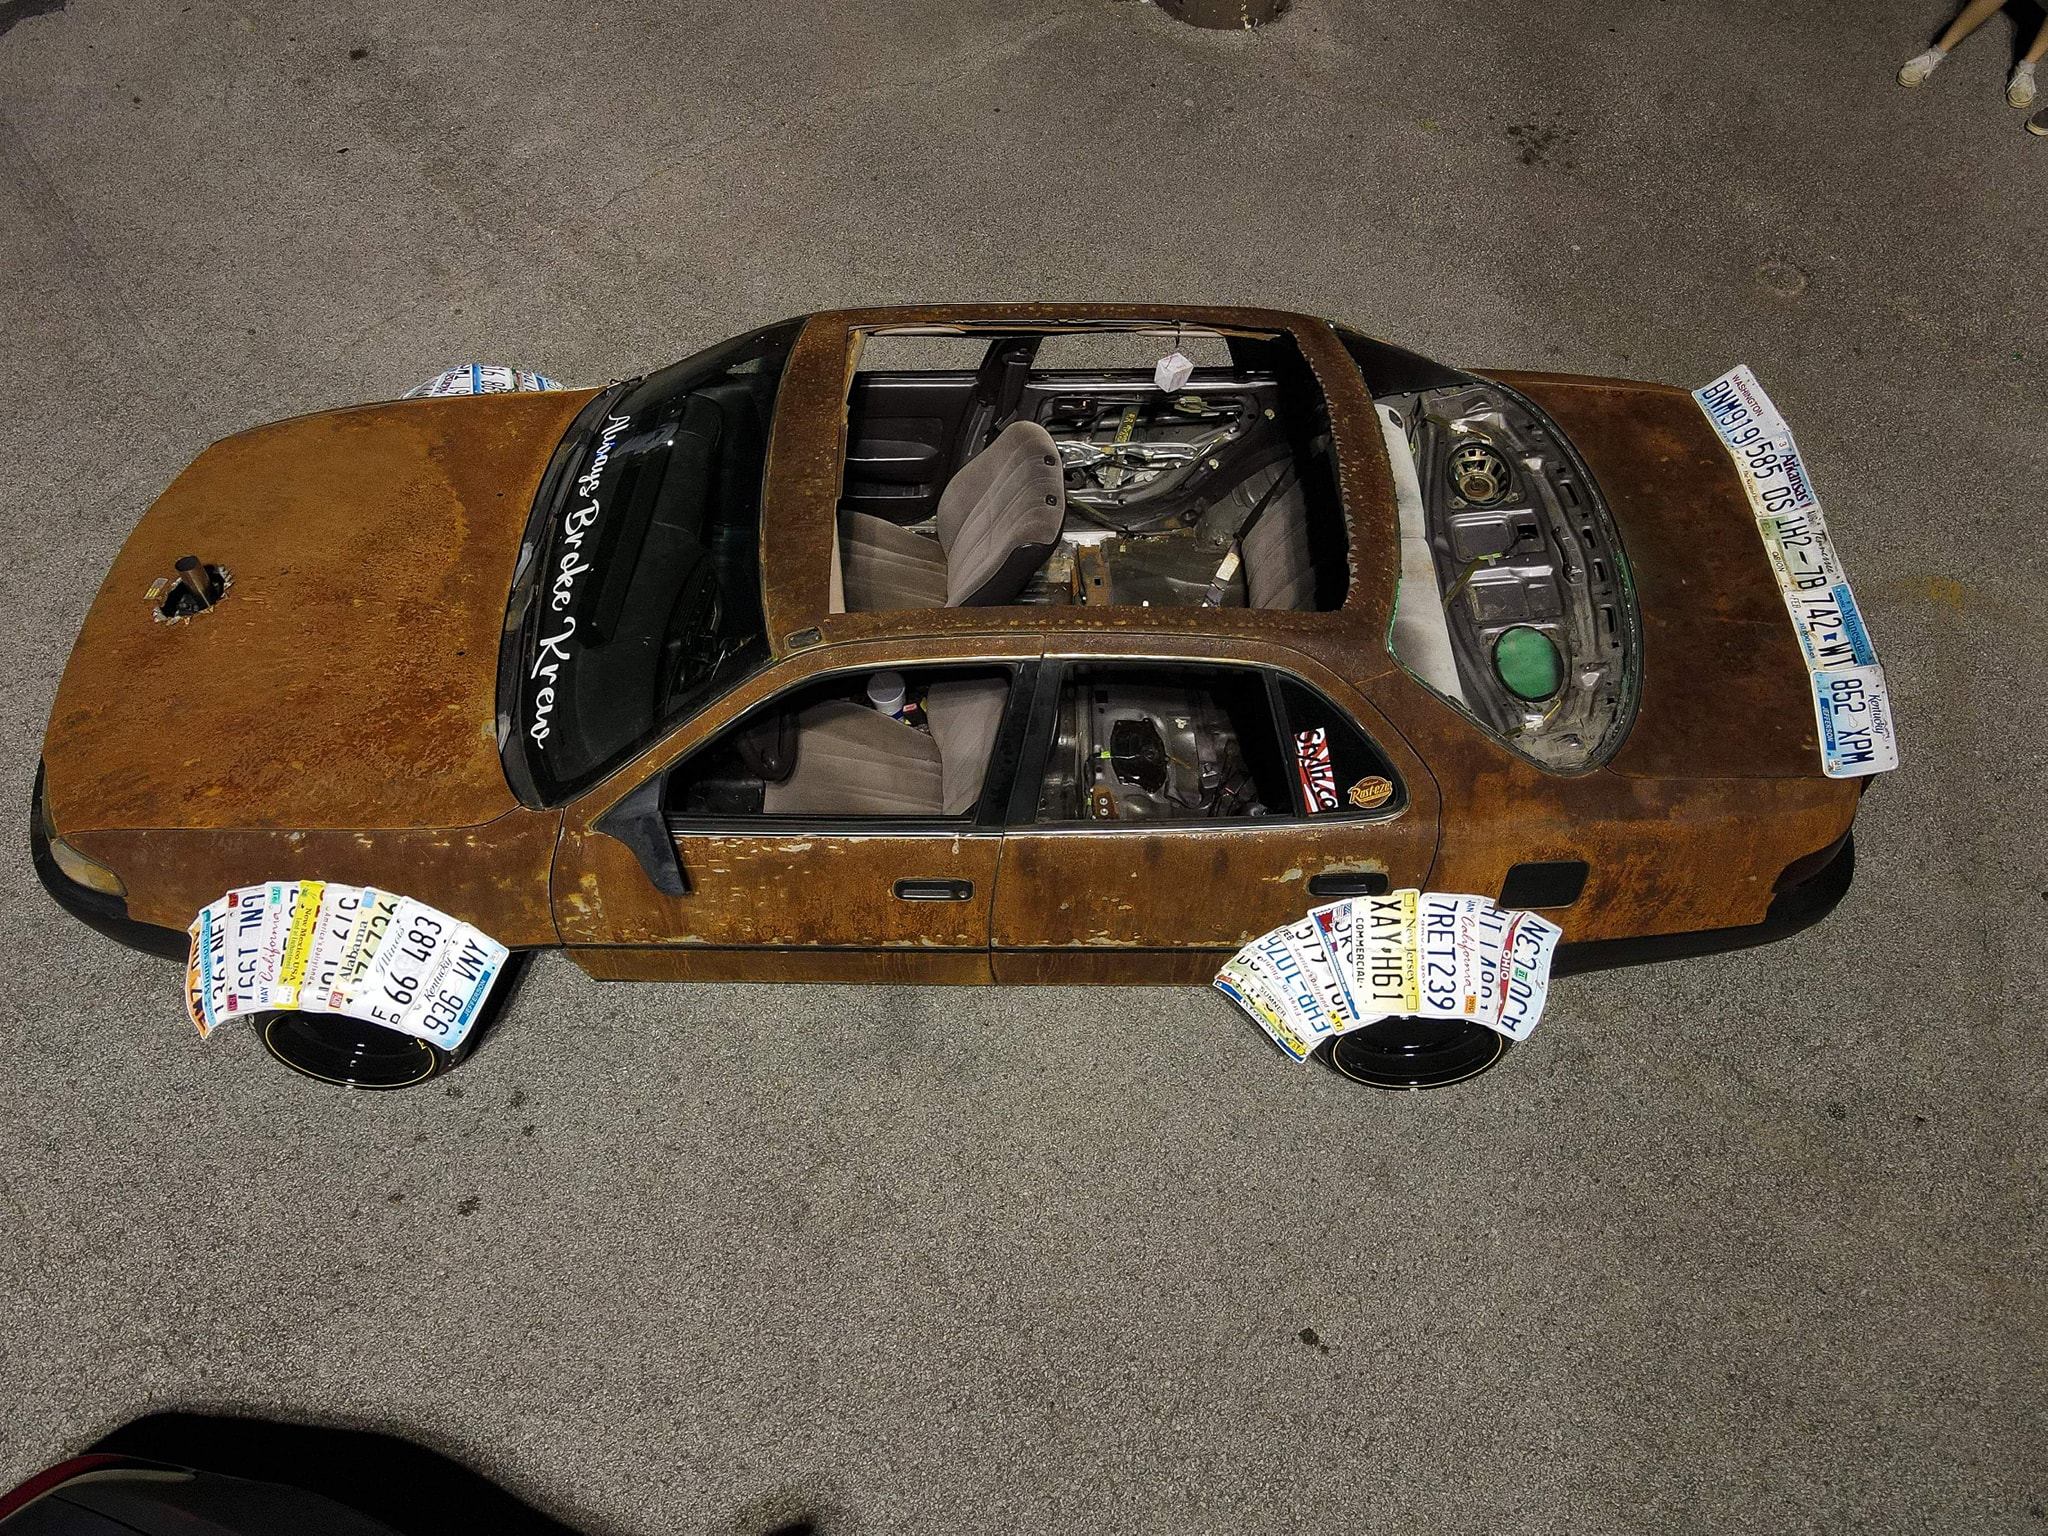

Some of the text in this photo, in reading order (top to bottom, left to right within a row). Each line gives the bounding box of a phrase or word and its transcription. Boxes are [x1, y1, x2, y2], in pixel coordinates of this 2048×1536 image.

[1702, 380, 1765, 447] BNM919
[1732, 374, 1763, 417] WASHINGTON
[1745, 440, 1782, 479] 585
[1781, 453, 1809, 502] Arkansas
[551, 499, 600, 612] Broke
[1811, 529, 1834, 573] Tennessee
[531, 617, 576, 750] Krew
[1822, 705, 1833, 742] JEFFERSON
[1830, 678, 1874, 765] 852 XPM
[1867, 693, 1885, 734] Kentucky
[289, 908, 311, 980] New Mexico USA
[317, 912, 330, 945] America's
[338, 918, 368, 982] Alabama
[375, 926, 405, 976] Illinois
[1279, 928, 1294, 941] FEB
[1354, 917, 1365, 983] COMMERCIAL
[1404, 917, 1417, 982] New Jersey
[1457, 900, 1475, 993] JAN California
[260, 906, 282, 1003] MAY California
[309, 947, 322, 979] Dairyland
[424, 956, 452, 1002] Kentucky
[1293, 947, 1329, 1008] America's Dairyland
[1427, 900, 1457, 1010] 7RET239
[1499, 949, 1510, 980] OHIO
[424, 938, 489, 1035] 936 VNY
[462, 978, 487, 1017] JEFFERSON
[1258, 985, 1286, 1017] SUMNER
